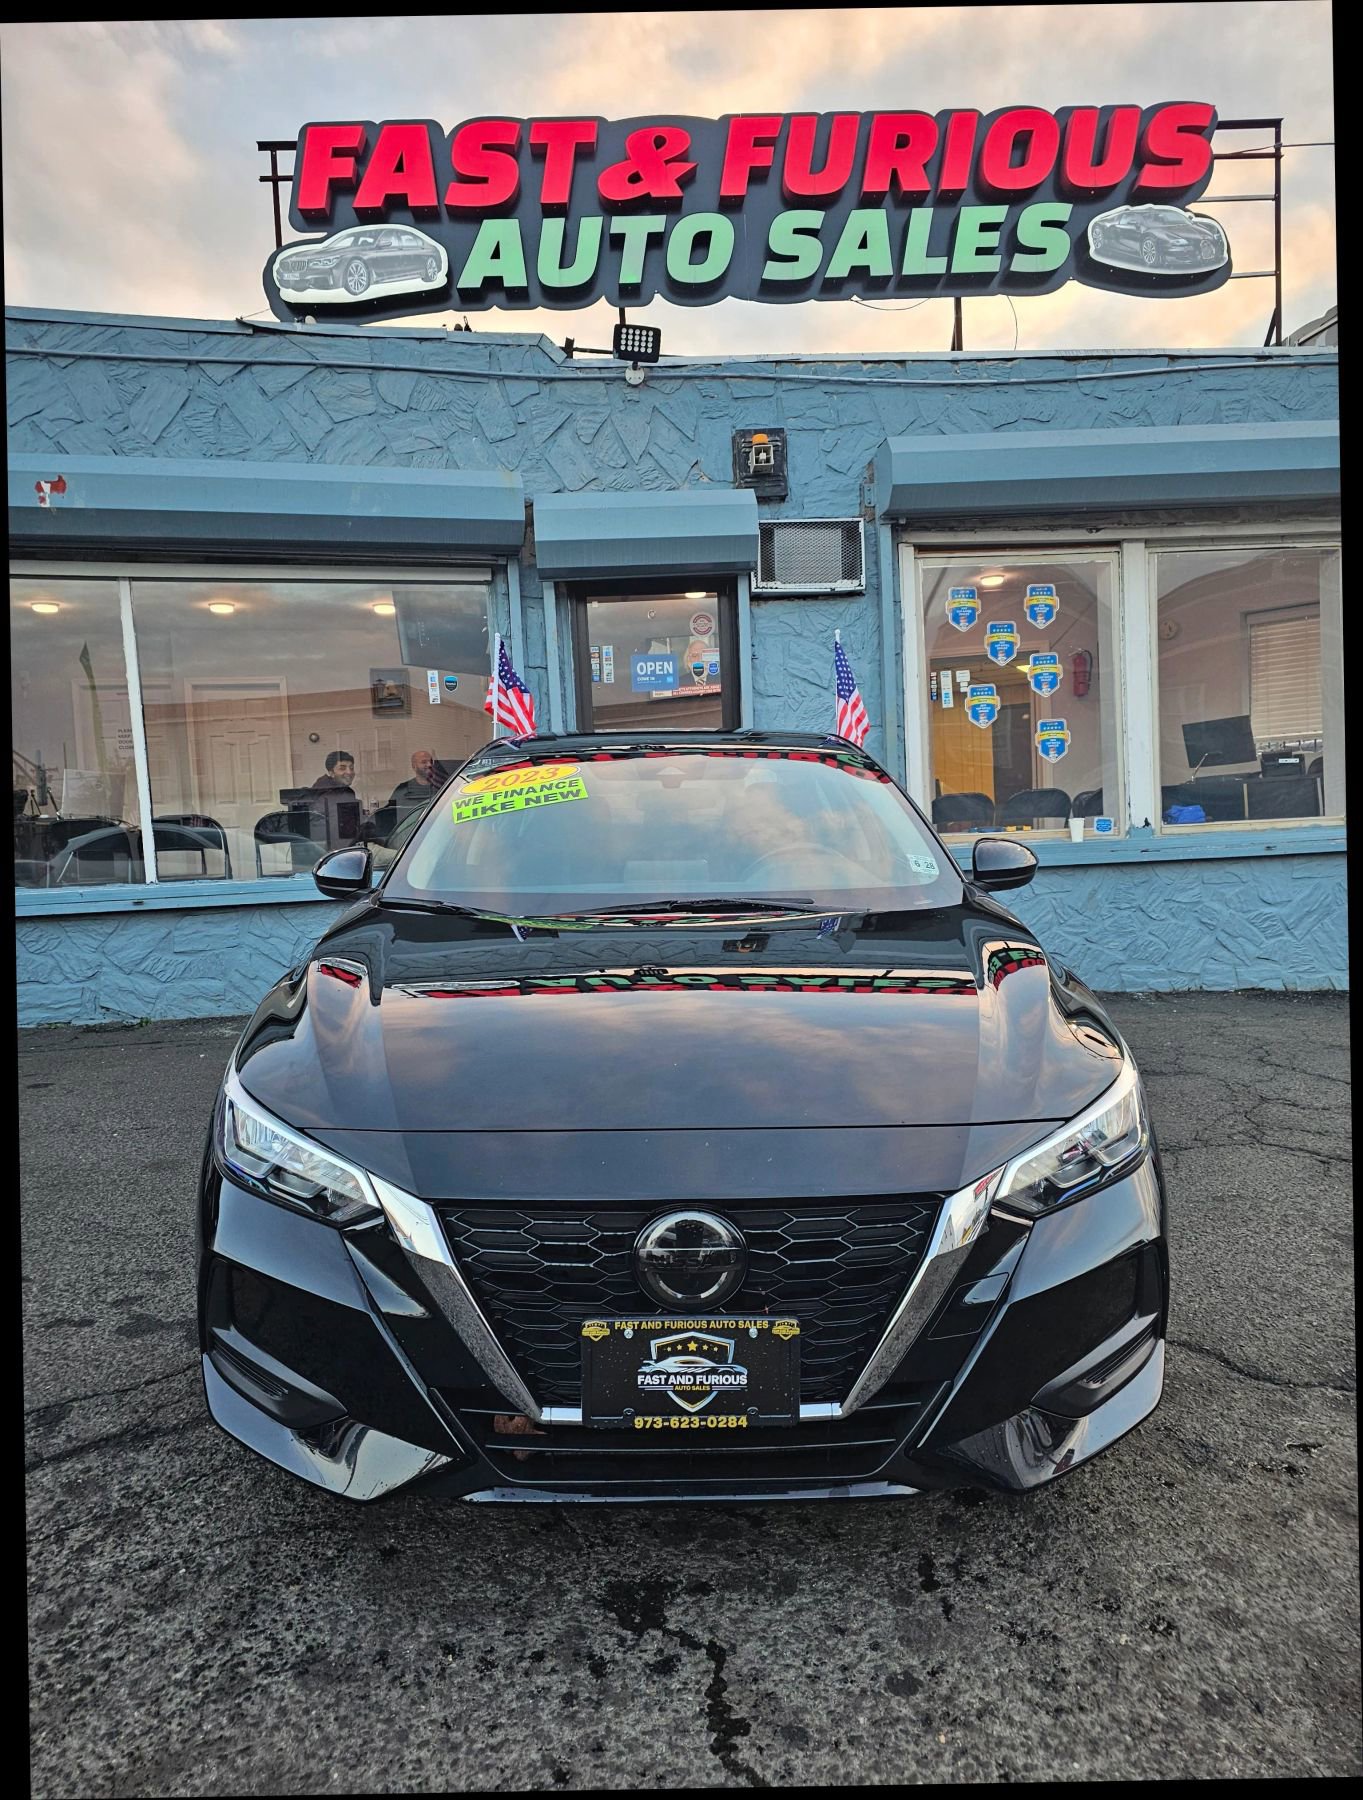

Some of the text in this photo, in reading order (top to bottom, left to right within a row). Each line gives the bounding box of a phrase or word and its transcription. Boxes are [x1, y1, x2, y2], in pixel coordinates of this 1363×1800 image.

[297, 103, 1216, 214] FAST & FURIOUS
[456, 202, 1073, 290] AUTO SALES
[636, 661, 673, 675] OPEN
[480, 767, 560, 792] 2023
[454, 778, 580, 809] WE FINANCE
[456, 789, 582, 821] LIKE NEW
[614, 1320, 769, 1330] FAST AND FURIOUS AUTO SALES
[637, 1374, 748, 1385] FAST AND FURIOUS
[634, 1416, 748, 1429] 973-623-0284
